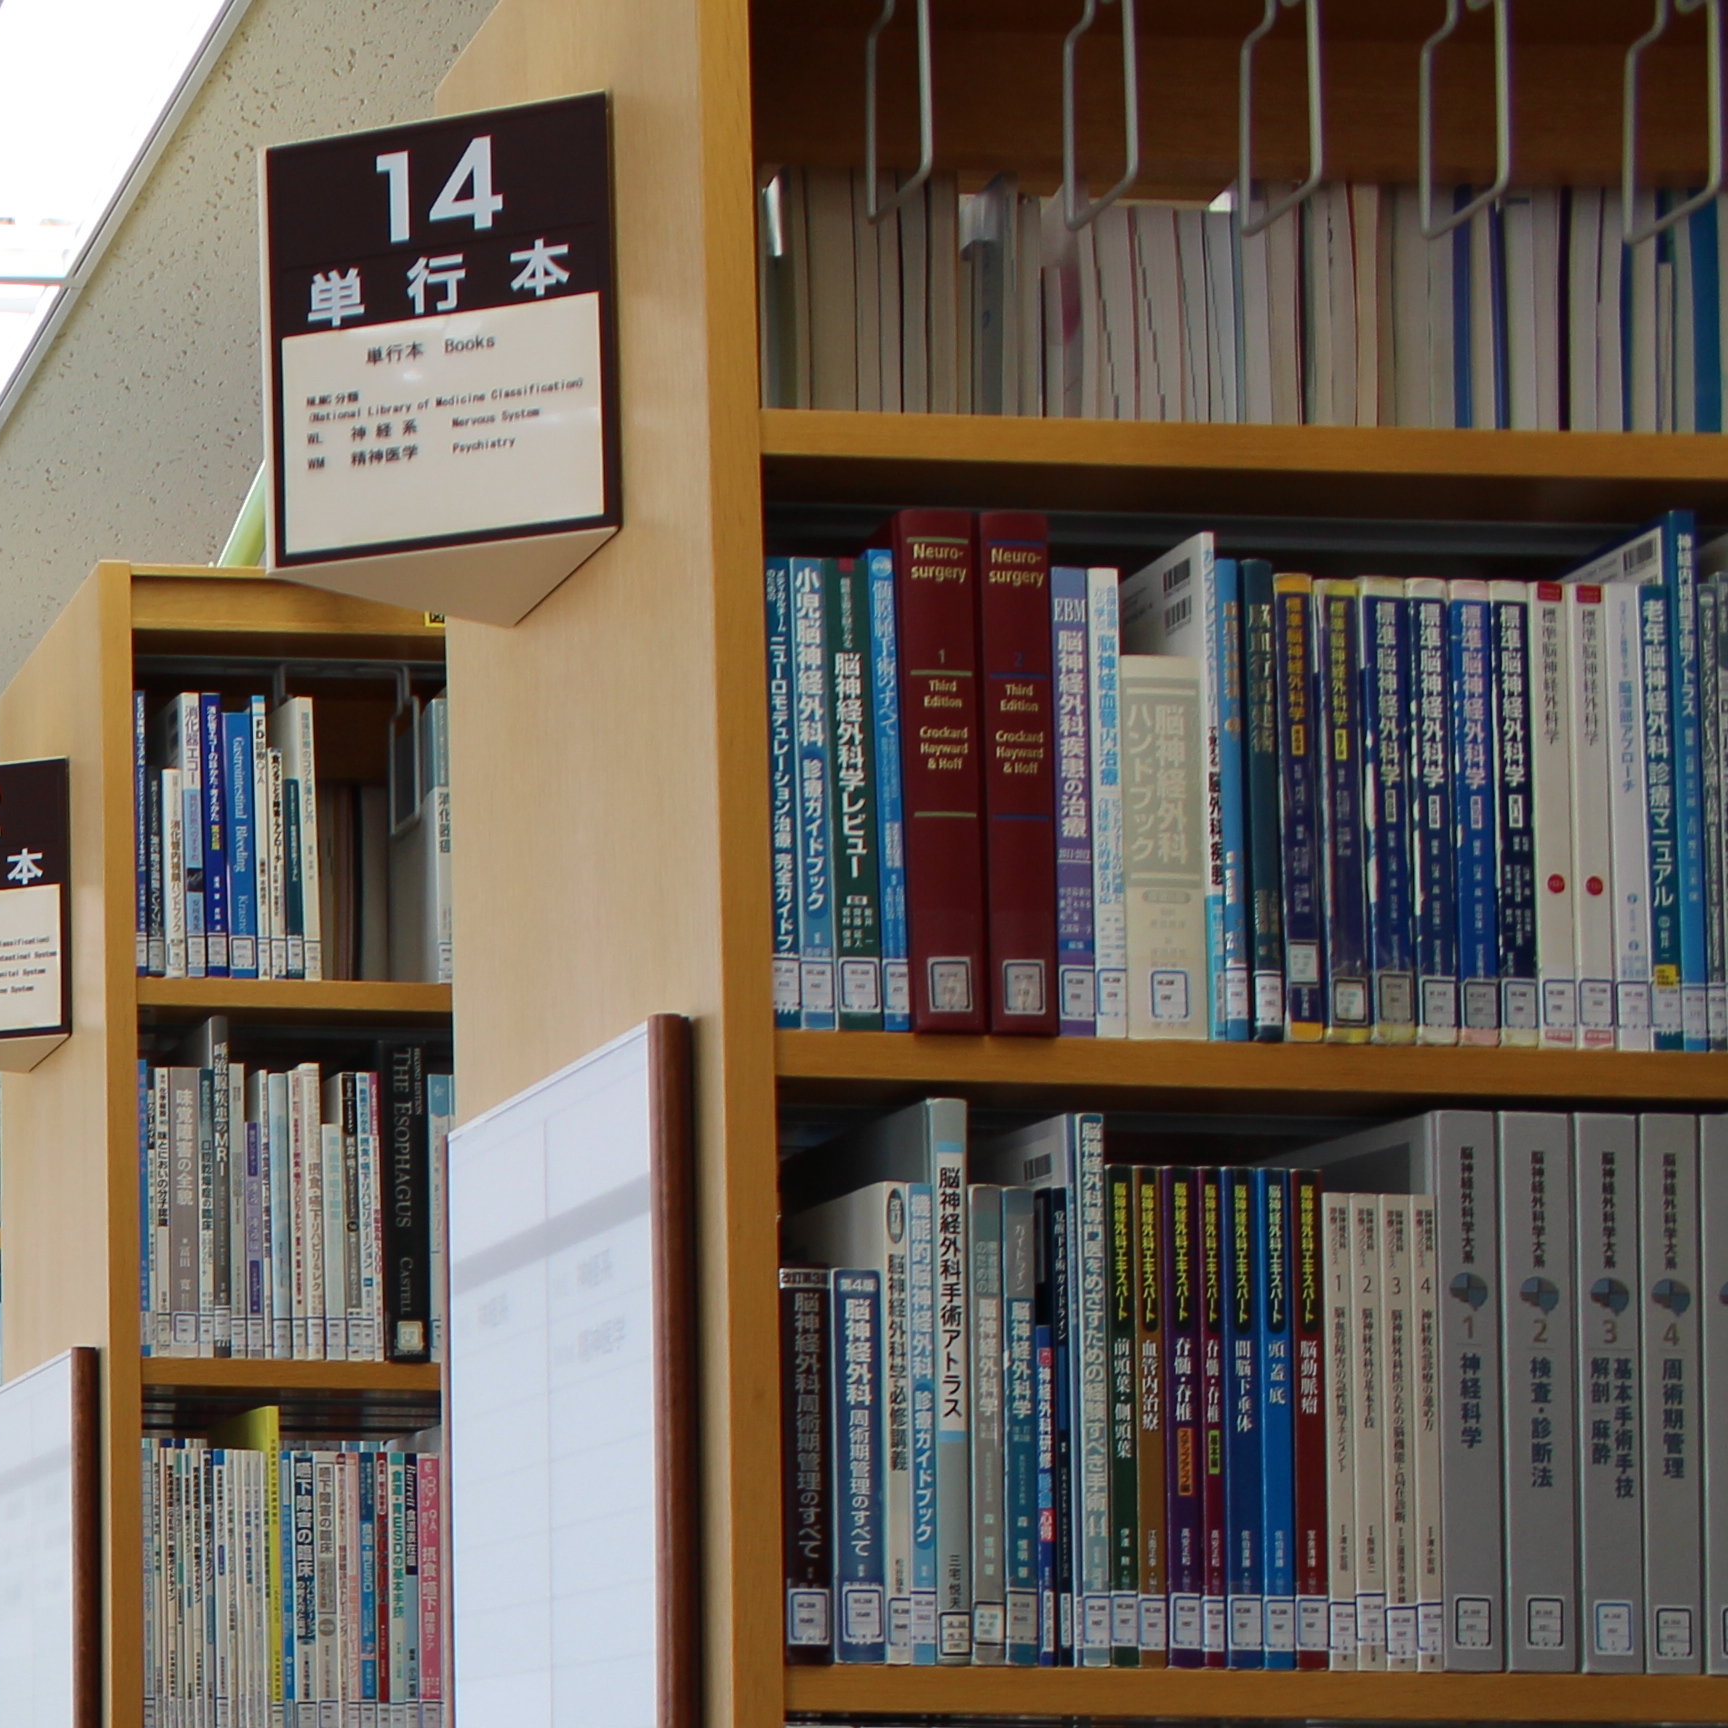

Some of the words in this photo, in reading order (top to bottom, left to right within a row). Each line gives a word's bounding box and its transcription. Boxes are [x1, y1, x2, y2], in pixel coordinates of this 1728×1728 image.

[376, 135, 503, 243] 14
[308, 239, 569, 326] 単行本
[365, 342, 424, 365] 単行本
[444, 334, 495, 354] Books
[350, 419, 418, 441] 神経系
[452, 414, 496, 428] Nervous
[502, 407, 540, 421] System
[368, 401, 412, 418] Library
[417, 399, 430, 411] of
[435, 393, 486, 408] Medicine
[491, 377, 585, 400] Classification)
[350, 443, 419, 467] 精神医学
[452, 436, 516, 455] Psychiatry
[911, 564, 966, 583] surgery
[913, 542, 964, 562] Neuro-
[989, 568, 1044, 587] surgery
[991, 547, 1041, 566] Neuro-
[1054, 598, 1086, 622] EBM
[794, 566, 825, 747] 小児脳神経外科
[929, 679, 956, 693] Third
[1005, 684, 1033, 698] Third
[920, 726, 968, 740] Crockard
[923, 694, 963, 709] Edition
[1000, 699, 1039, 713] Edition
[1058, 630, 1087, 838] 脳神経外科疾患の治療
[1419, 603, 1444, 789] 標準脳神経外科学
[1461, 605, 1486, 790] 標準脳神経外科学
[1500, 604, 1525, 788] 標準脳神経外科学
[232, 737, 248, 820] Gastrointestinal
[835, 652, 867, 878] 脳神経外科学レビュー
[921, 742, 969, 757] Hayward
[940, 757, 963, 770] Hoff
[996, 746, 1043, 761] Hayward
[1127, 704, 1155, 861] ハンドブック
[1155, 704, 1187, 863] 脳神経外科
[234, 824, 248, 873] Bleeding
[394, 1051, 413, 1093] THE
[394, 1101, 413, 1227] ESOPHAGUS
[1460, 1145, 1474, 1264] 脳神経外科学大系
[1530, 1150, 1545, 1269] 脳神経外科学大系
[1601, 1151, 1617, 1270] 脳神経外科学大系
[1663, 1152, 1678, 1270] 脳神経外科学大系
[400, 1256, 414, 1314] CASTELL
[840, 1278, 877, 1291] 第4版
[939, 1167, 962, 1418] 脳神経外科手術アトラス
[1362, 1275, 1372, 1294] 2
[1392, 1276, 1401, 1295] 3
[845, 1298, 872, 1406] 脳神経外科
[978, 1299, 997, 1416] 脳神経外科学
[1011, 1302, 1032, 1419] 脳神経外科学
[1532, 1319, 1548, 1343] 2
[1603, 1320, 1618, 1344] 3
[1663, 1322, 1679, 1346] 4
[1114, 1338, 1132, 1459] 前頭葉・側頭葉
[1141, 1339, 1159, 1431] 血管内治療
[1174, 1337, 1192, 1422] 脊髄・脊椎
[1235, 1340, 1253, 1433] 間脳下垂体
[1268, 1341, 1286, 1405] 頭蓋底
[1301, 1341, 1318, 1414] 脳動脈瘤
[1460, 1352, 1482, 1450] 神経科学
[1590, 1357, 1610, 1405] 解剖
[1530, 1357, 1554, 1489] 検査・診断法
[1590, 1416, 1612, 1466] 麻酔
[1614, 1357, 1634, 1500] 基本手術手技
[1662, 1359, 1685, 1479] 周術期管理
[296, 1461, 314, 1578] 嚥下障害の臨床
[318, 1470, 332, 1555] 嚥下障害の臨床
[405, 1464, 416, 1507] Barrett
[848, 1409, 872, 1557] 周術期管理のすべて
